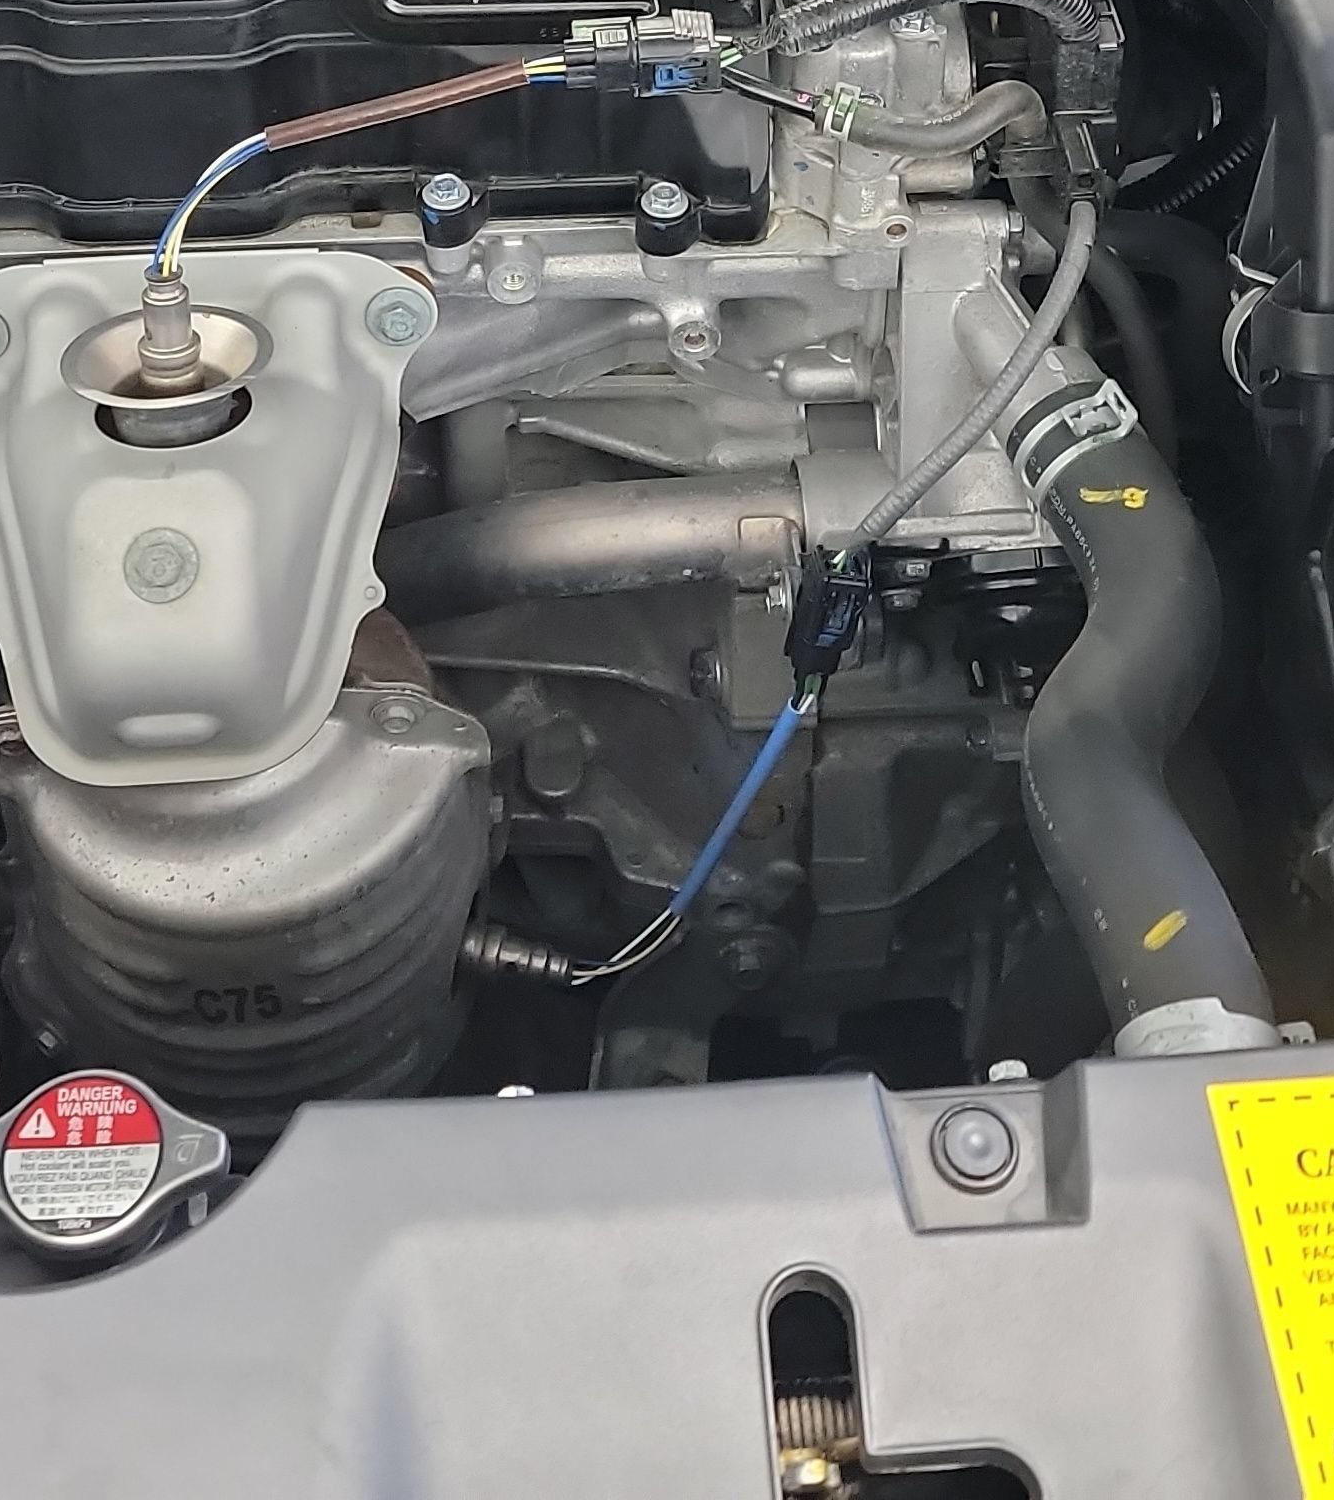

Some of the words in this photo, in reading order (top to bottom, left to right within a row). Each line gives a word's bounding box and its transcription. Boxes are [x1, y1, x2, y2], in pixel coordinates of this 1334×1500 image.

[193, 985, 283, 1024] C75
[58, 1085, 124, 1102] DANGER
[56, 1099, 137, 1117] WARNUNG
